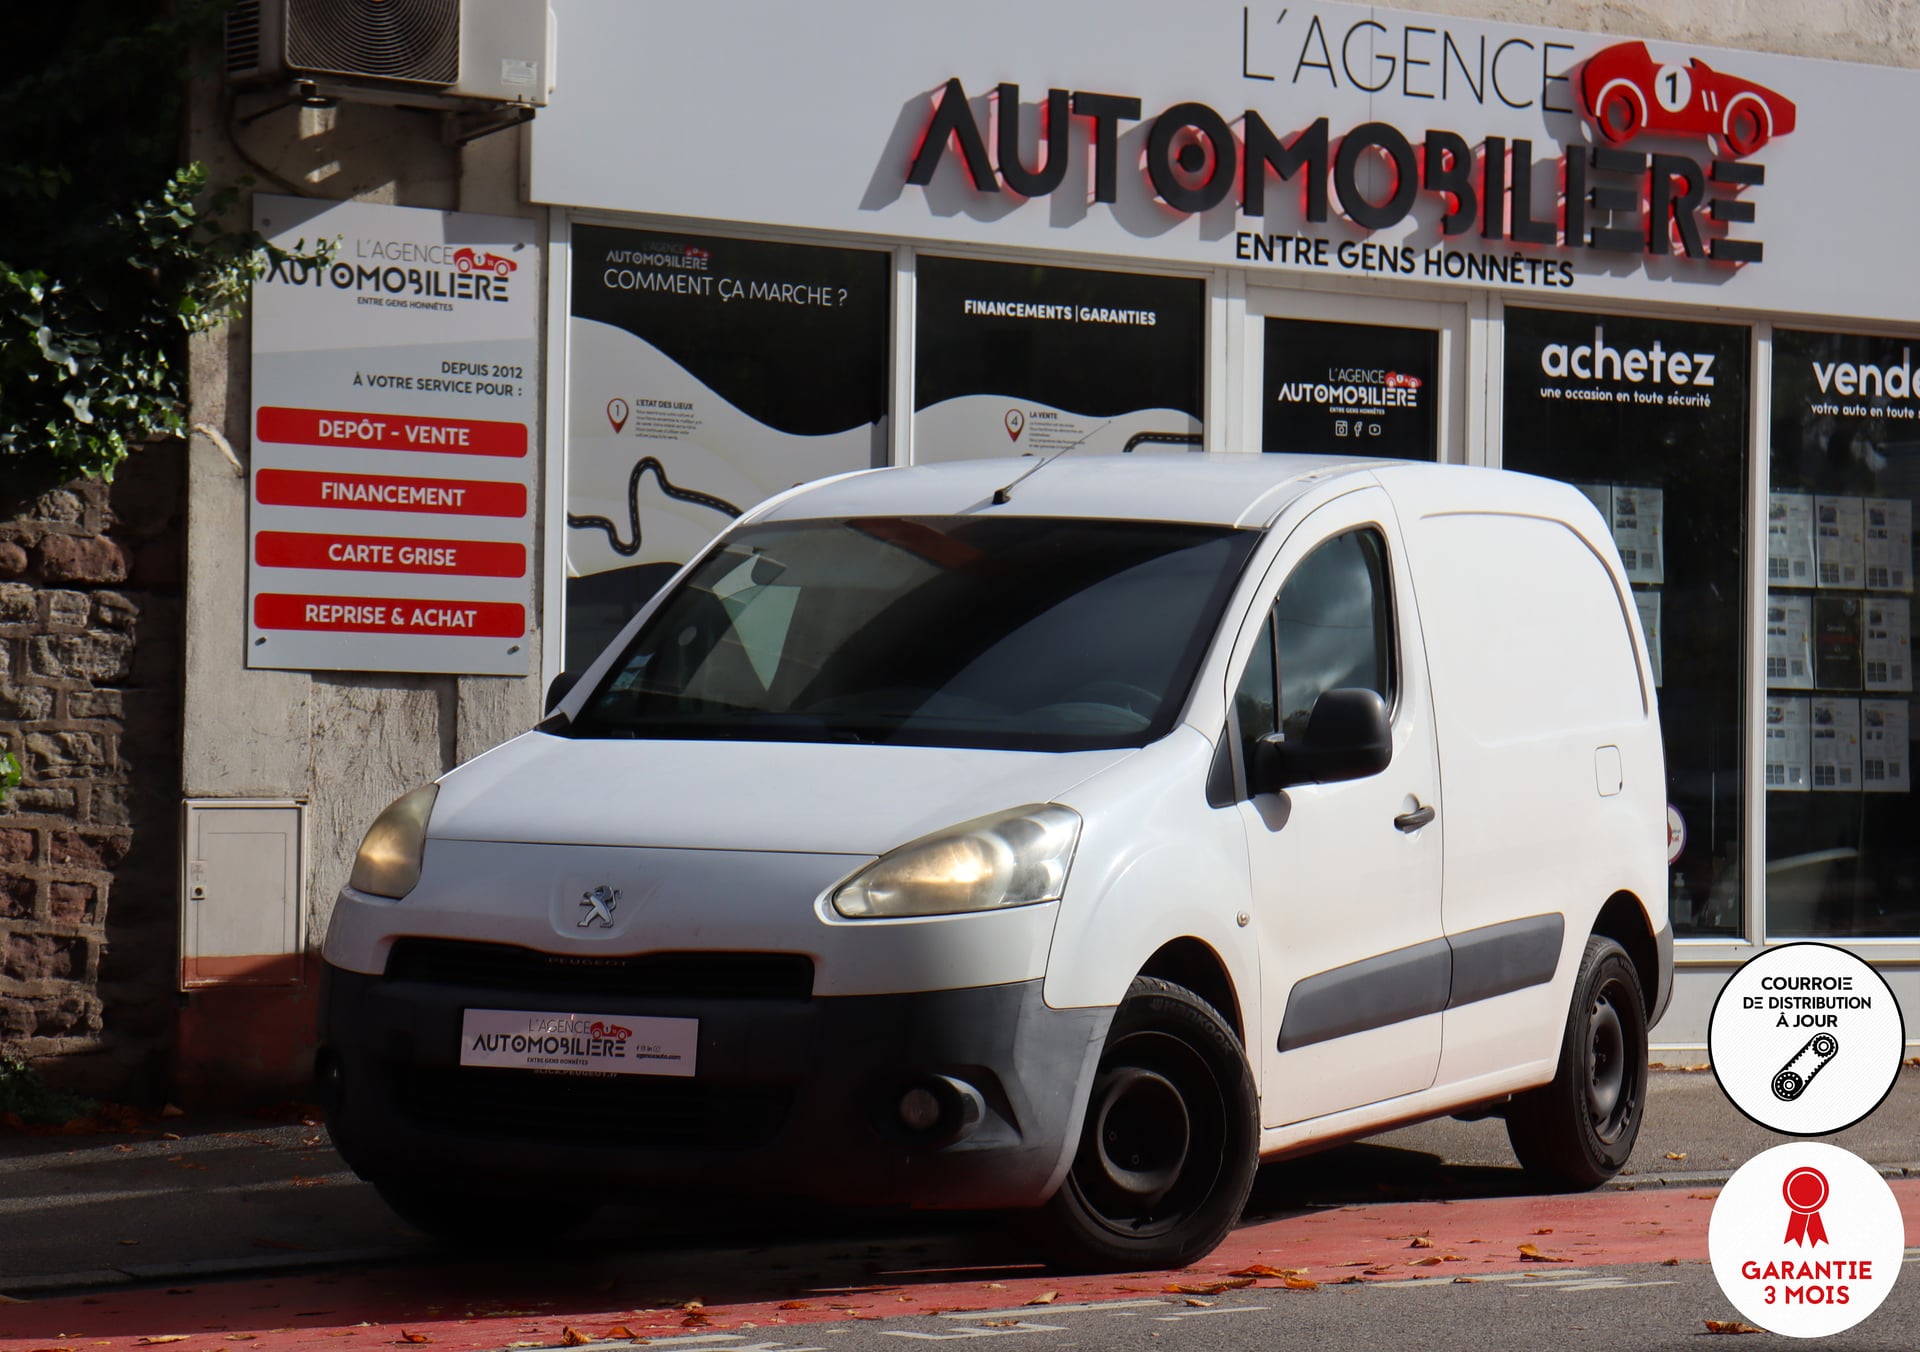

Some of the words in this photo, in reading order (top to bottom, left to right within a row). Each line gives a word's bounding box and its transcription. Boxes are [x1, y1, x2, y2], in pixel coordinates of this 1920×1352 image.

[1242, 6, 1576, 115] L'AGENCE
[1664, 72, 1678, 104] 1
[357, 239, 454, 265] L'AGENCE
[1236, 232, 1330, 267] ENTRE
[1337, 241, 1416, 273] GENS
[1424, 248, 1575, 288] HONNÊTES
[603, 268, 714, 296] COMMENT
[718, 277, 745, 302] ÇA
[750, 281, 833, 307] MARCHE
[837, 288, 848, 307] ?
[357, 297, 384, 306] ENTRE
[385, 299, 408, 309] GENS
[409, 300, 454, 312] HONNÊTES
[964, 299, 1073, 321] FINANCEMENTS
[1080, 307, 1157, 327] GARANTIES
[1541, 325, 1715, 387] achetez
[441, 361, 489, 377] DEPUIS
[492, 365, 523, 379] 2012
[1328, 367, 1385, 384] L'AGENCE
[353, 371, 363, 386] À
[367, 374, 413, 390] VOTRE
[416, 378, 472, 394] SERVICE
[476, 381, 514, 396] POUR
[658, 400, 672, 409] DES
[673, 402, 694, 411] LIEUX
[1540, 388, 1562, 399] une
[1565, 386, 1613, 402] occasion
[1617, 391, 1631, 403] en
[1633, 390, 1664, 405] toute
[1667, 391, 1711, 408] sécurité
[1011, 415, 1018, 426] 4
[1029, 411, 1037, 419] LA
[1039, 412, 1058, 420] VENTE
[1811, 402, 1839, 416] votre
[1842, 404, 1867, 416] auto
[1870, 407, 1883, 417] en
[1886, 406, 1915, 419] toute
[318, 418, 386, 441] DEPÔT
[405, 424, 470, 446] VENTE
[321, 481, 466, 507] FINANCEMENT
[328, 543, 394, 564] CARTE
[398, 546, 457, 567] GRISE
[305, 603, 386, 625] REPRISE
[390, 607, 405, 626] &
[410, 608, 478, 628] ACHAT
[528, 1017, 591, 1034] L'AGENCE
[544, 1057, 559, 1065] GENS
